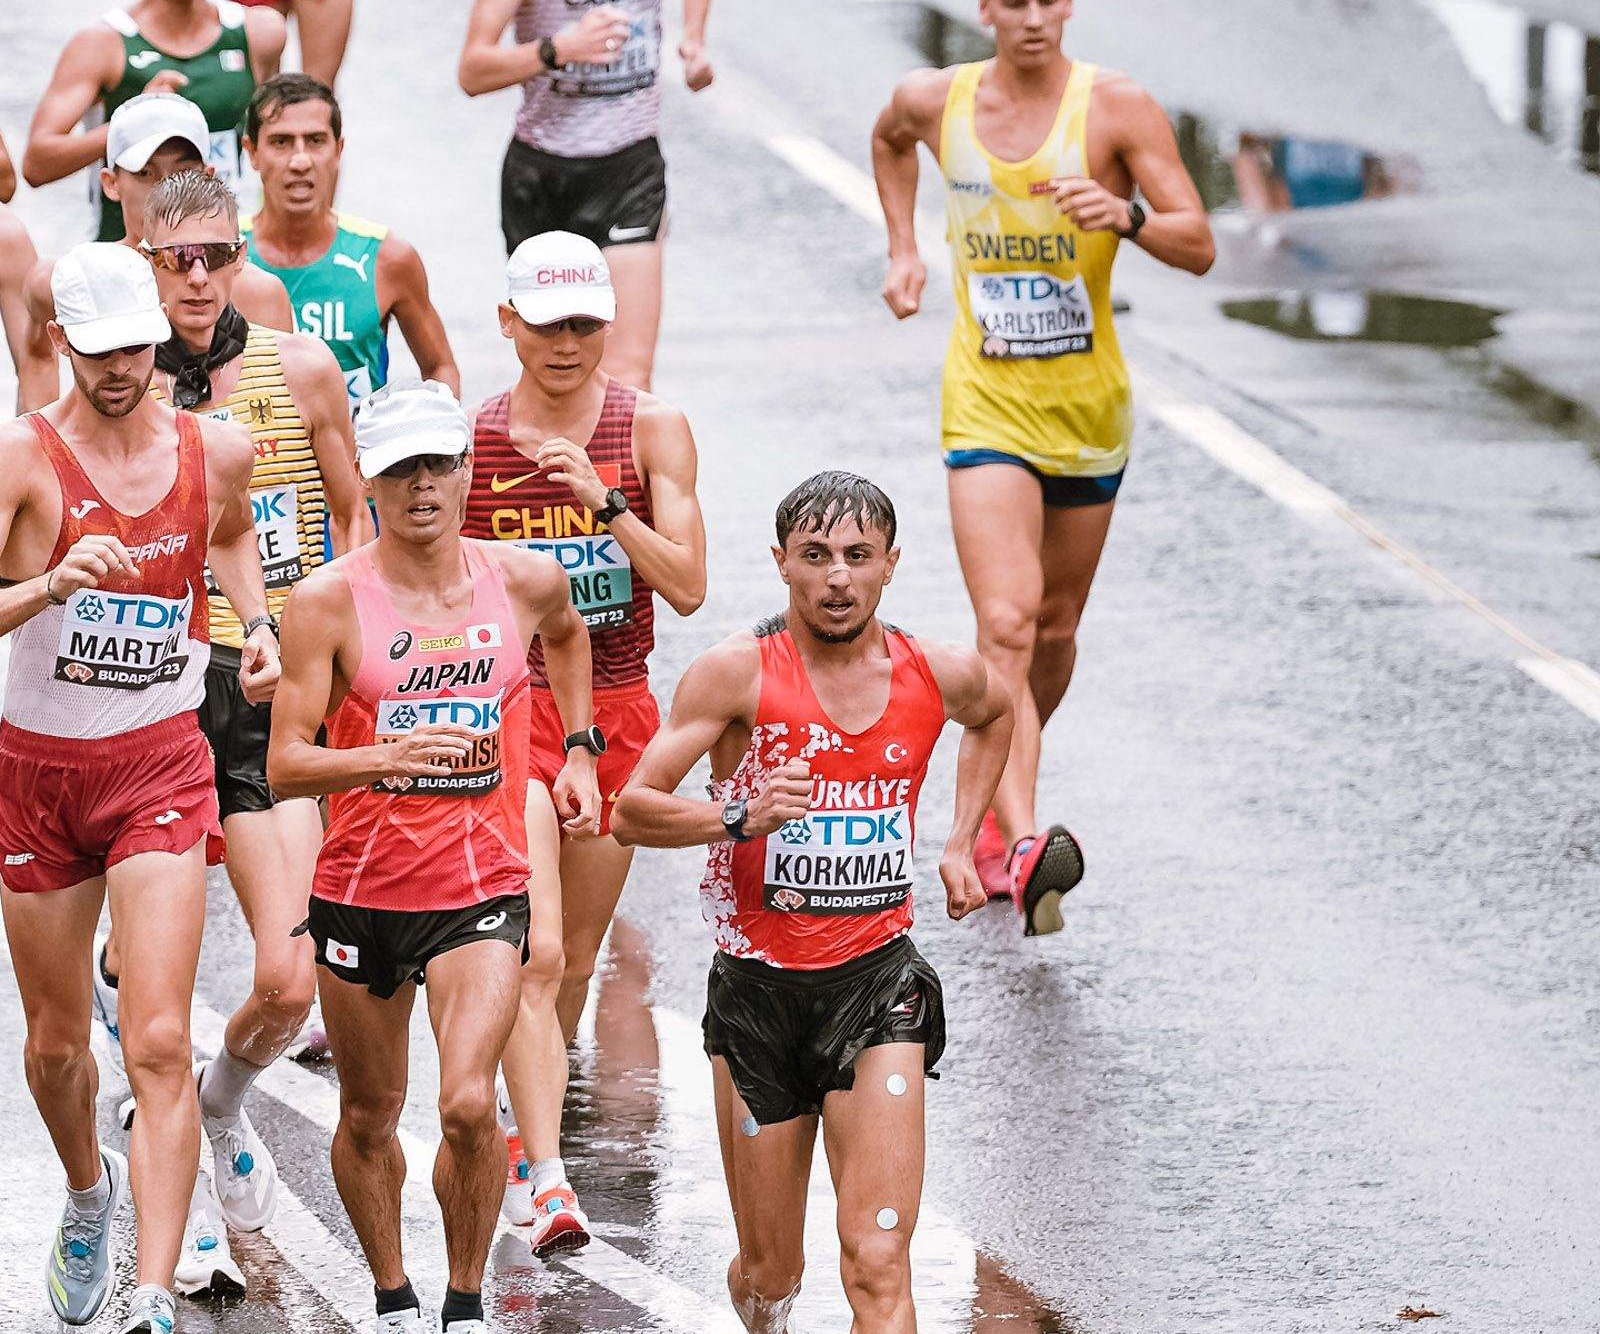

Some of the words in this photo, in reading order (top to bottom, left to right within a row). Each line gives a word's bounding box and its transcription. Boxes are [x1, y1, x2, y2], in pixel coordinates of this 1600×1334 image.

[966, 233, 1076, 262] SWEDEN
[536, 269, 597, 285] CHINA
[1004, 278, 1080, 302] TDK
[293, 301, 354, 341] SIL
[979, 307, 1087, 334] KARLSTRÖM
[107, 597, 190, 630] TDK
[608, 609, 625, 622] 23
[69, 630, 181, 666] MARTÍN
[419, 635, 463, 651] SEIKO
[97, 665, 163, 685] BUDAPET
[164, 662, 181, 676] 23
[397, 657, 495, 694] JAPAN
[419, 699, 501, 731] TDK
[417, 773, 494, 791] BUDAPEST
[812, 810, 903, 846] TDK
[774, 848, 907, 886] KORKMAZ
[810, 892, 888, 908] BUDAPEST
